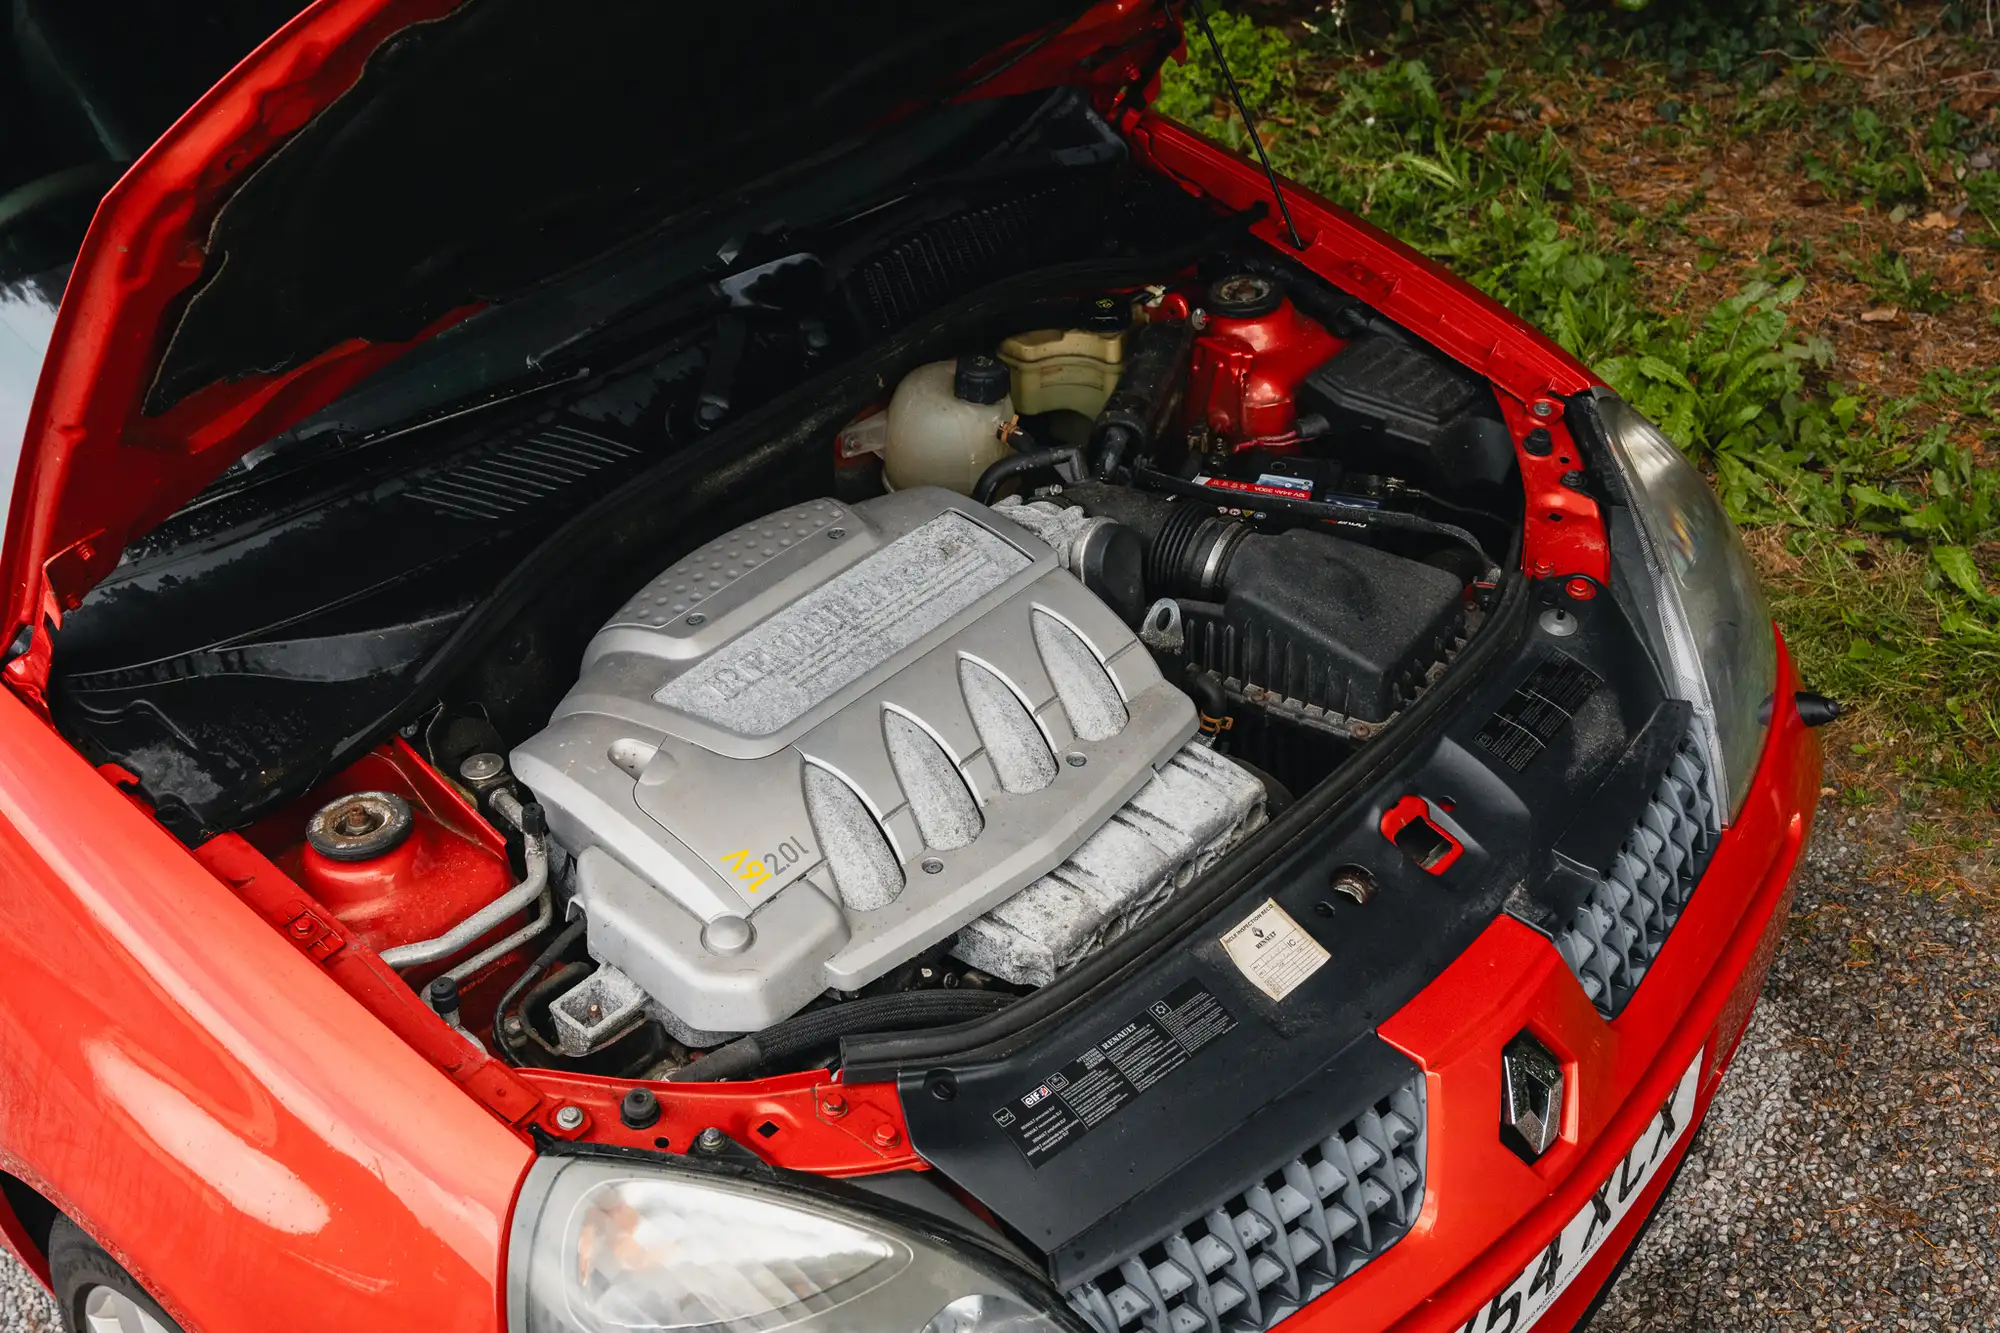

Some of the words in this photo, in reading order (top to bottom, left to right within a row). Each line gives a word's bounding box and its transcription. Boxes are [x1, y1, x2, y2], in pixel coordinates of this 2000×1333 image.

[720, 849, 772, 893] 16V
[1255, 930, 1277, 950] RENAULT
[1101, 1023, 1137, 1050] RENAULT
